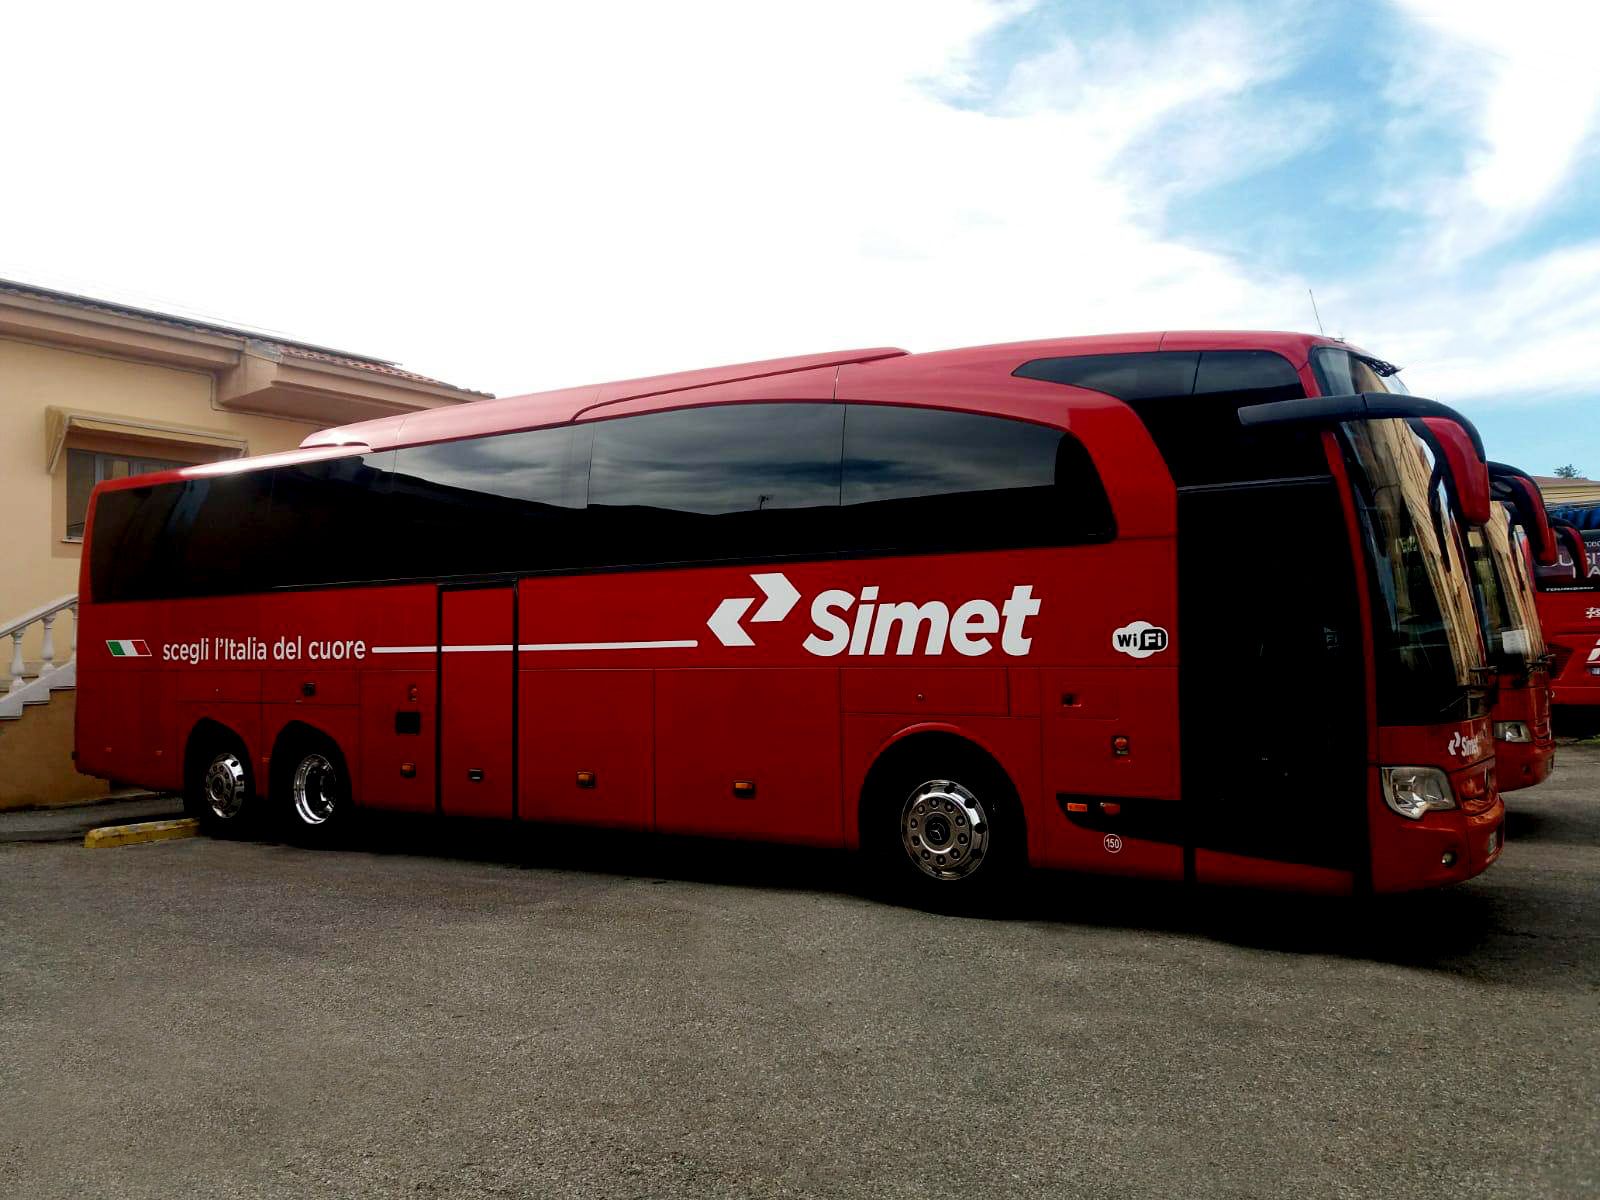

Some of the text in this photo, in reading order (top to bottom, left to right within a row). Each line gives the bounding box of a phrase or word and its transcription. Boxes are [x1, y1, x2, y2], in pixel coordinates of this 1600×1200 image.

[803, 584, 1041, 656] Simet
[163, 635, 366, 664] scegli l'Italia del cuore
[1105, 838, 1120, 849] 150
